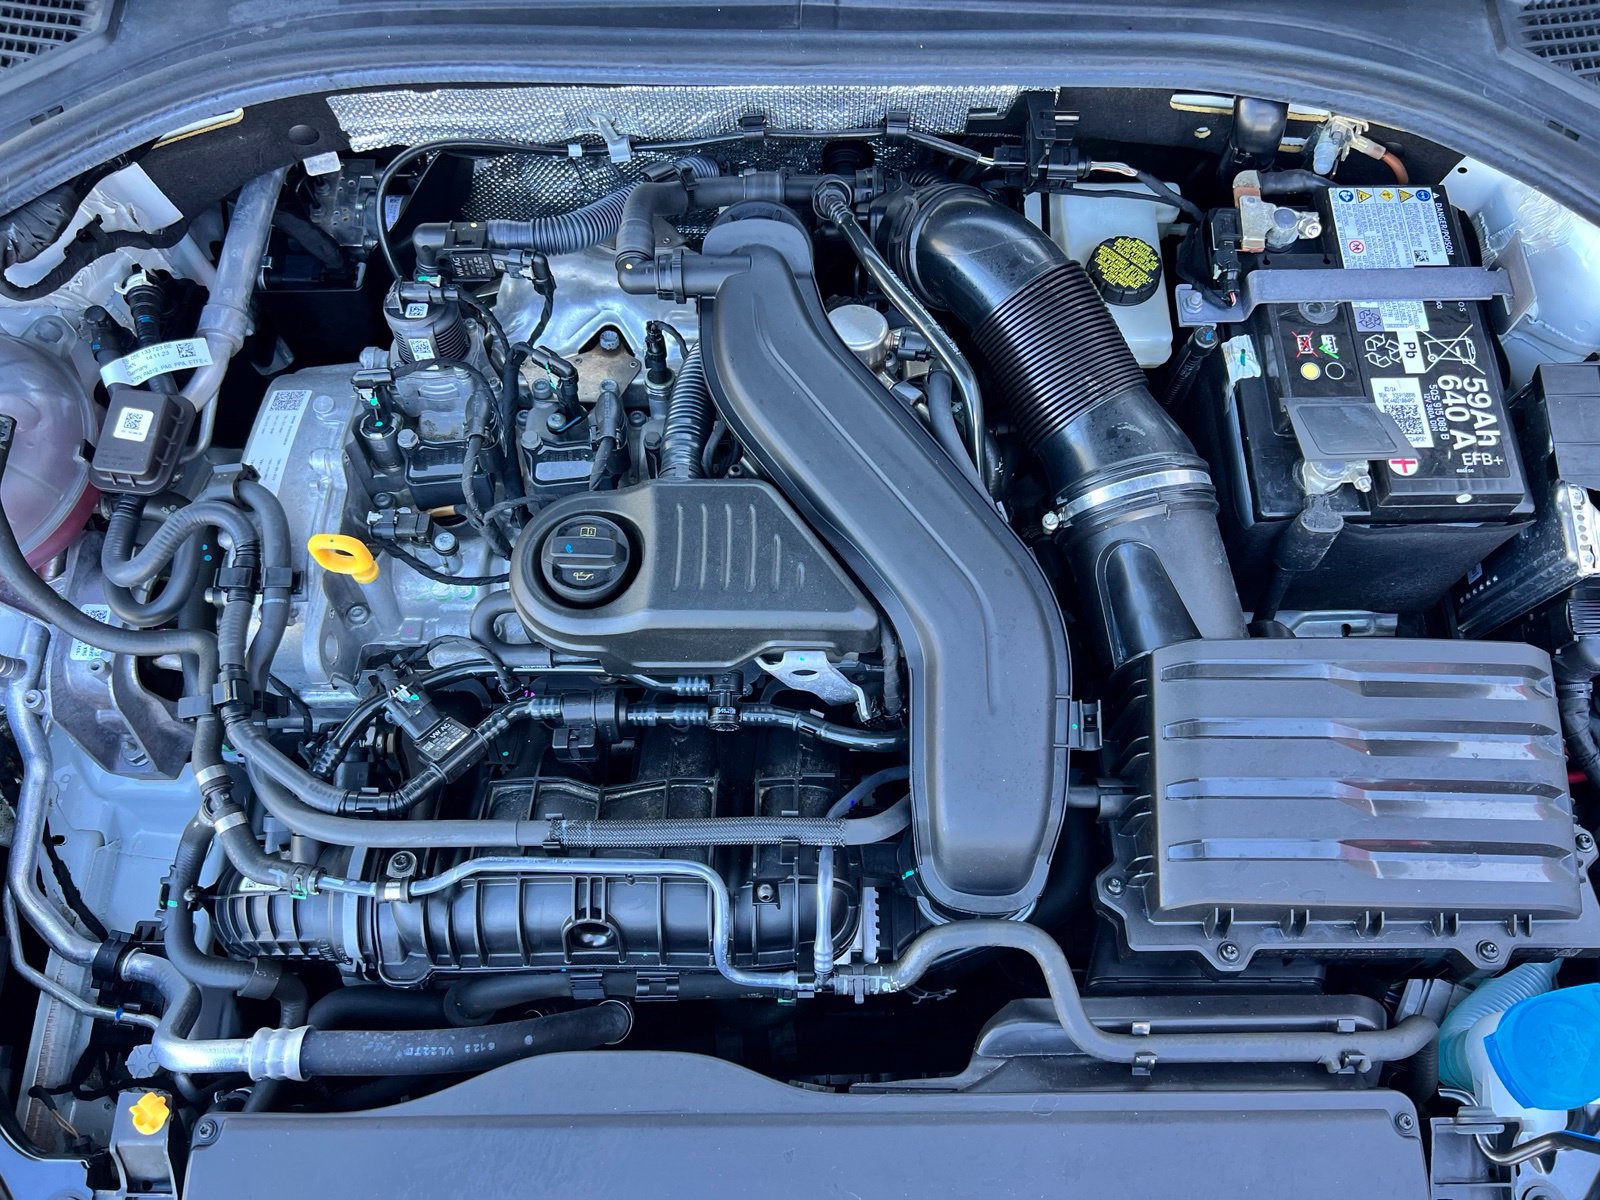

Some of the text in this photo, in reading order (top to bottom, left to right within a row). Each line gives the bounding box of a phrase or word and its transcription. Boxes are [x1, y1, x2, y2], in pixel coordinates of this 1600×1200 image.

[1435, 203, 1455, 256] DANGER/POISON
[1403, 342, 1417, 359] Pb
[1433, 402, 1444, 415] 915
[1437, 375, 1470, 422] 640
[1463, 376, 1500, 446] 59Ah
[1449, 429, 1477, 450] A
[1461, 452, 1504, 466] EFB+
